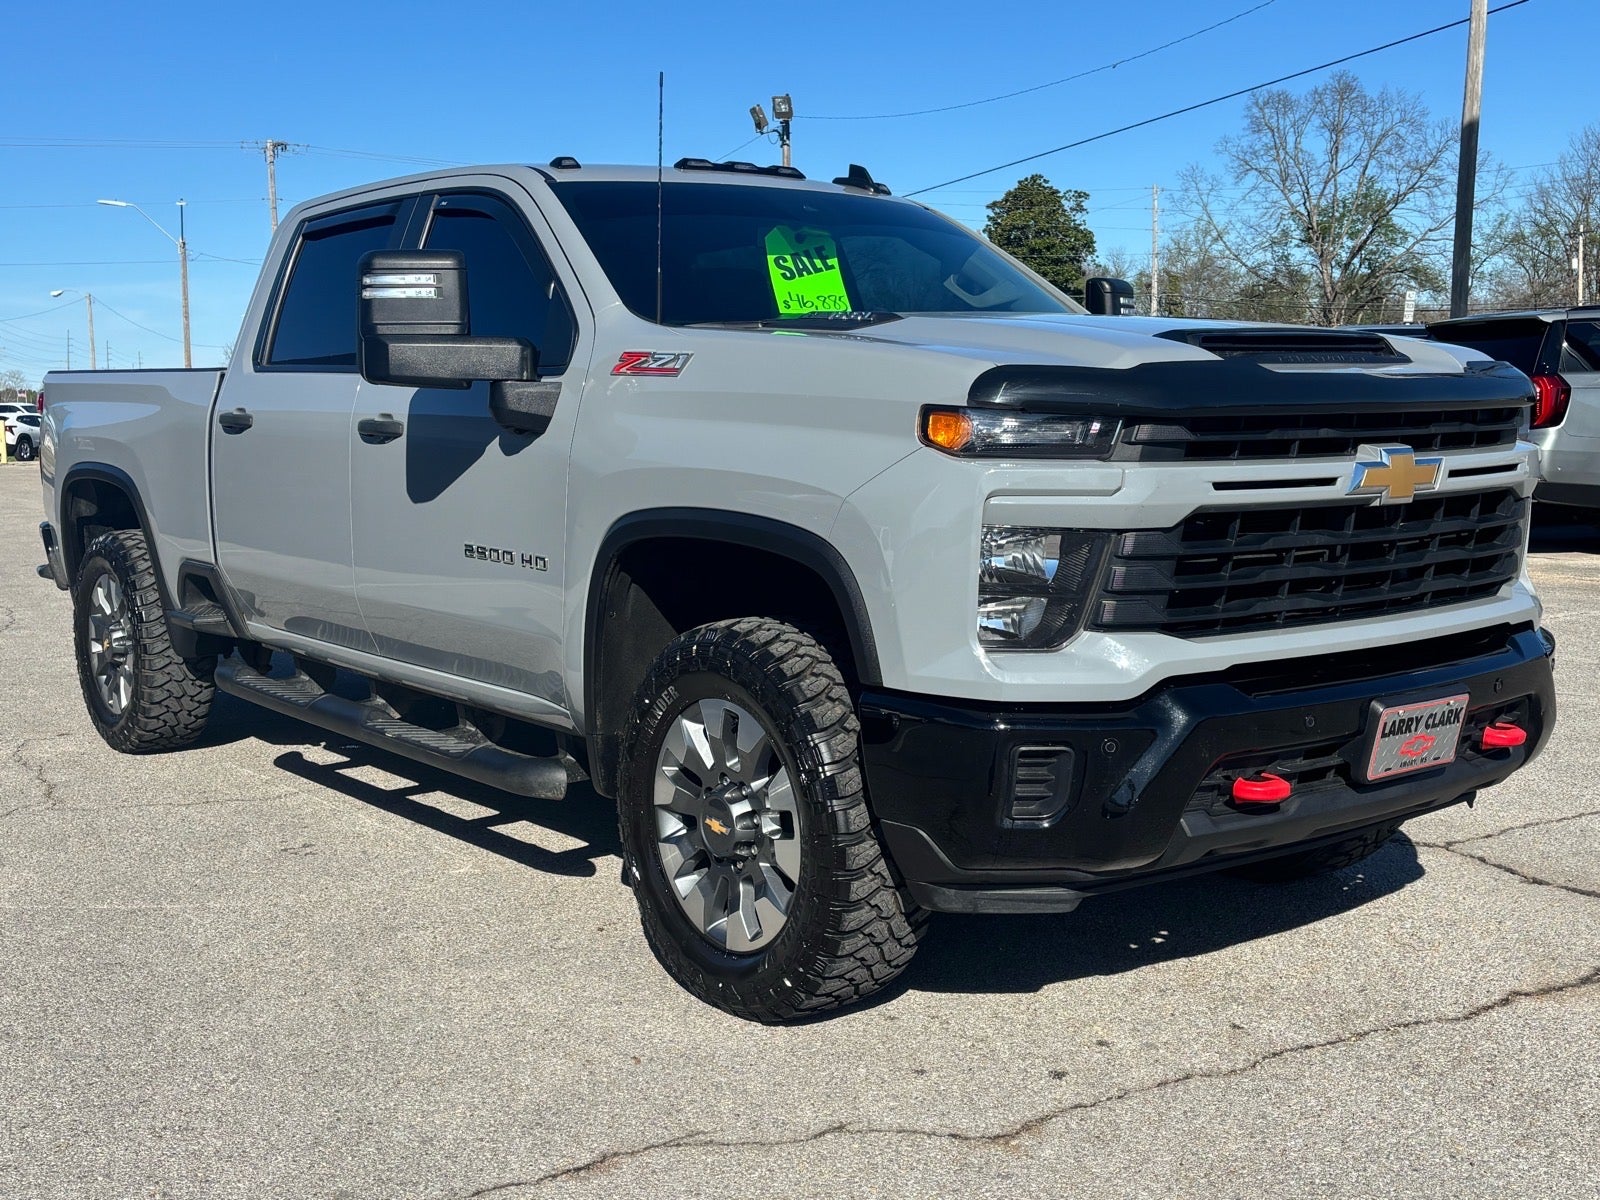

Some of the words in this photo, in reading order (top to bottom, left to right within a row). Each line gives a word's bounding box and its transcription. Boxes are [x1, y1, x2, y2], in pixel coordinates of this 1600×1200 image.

[773, 245, 836, 281] SALE
[611, 352, 693, 377] Z71
[464, 543, 516, 565] 2500
[521, 553, 548, 571] HD
[1381, 715, 1424, 739] LARRY
[1424, 707, 1464, 730] CLARK
